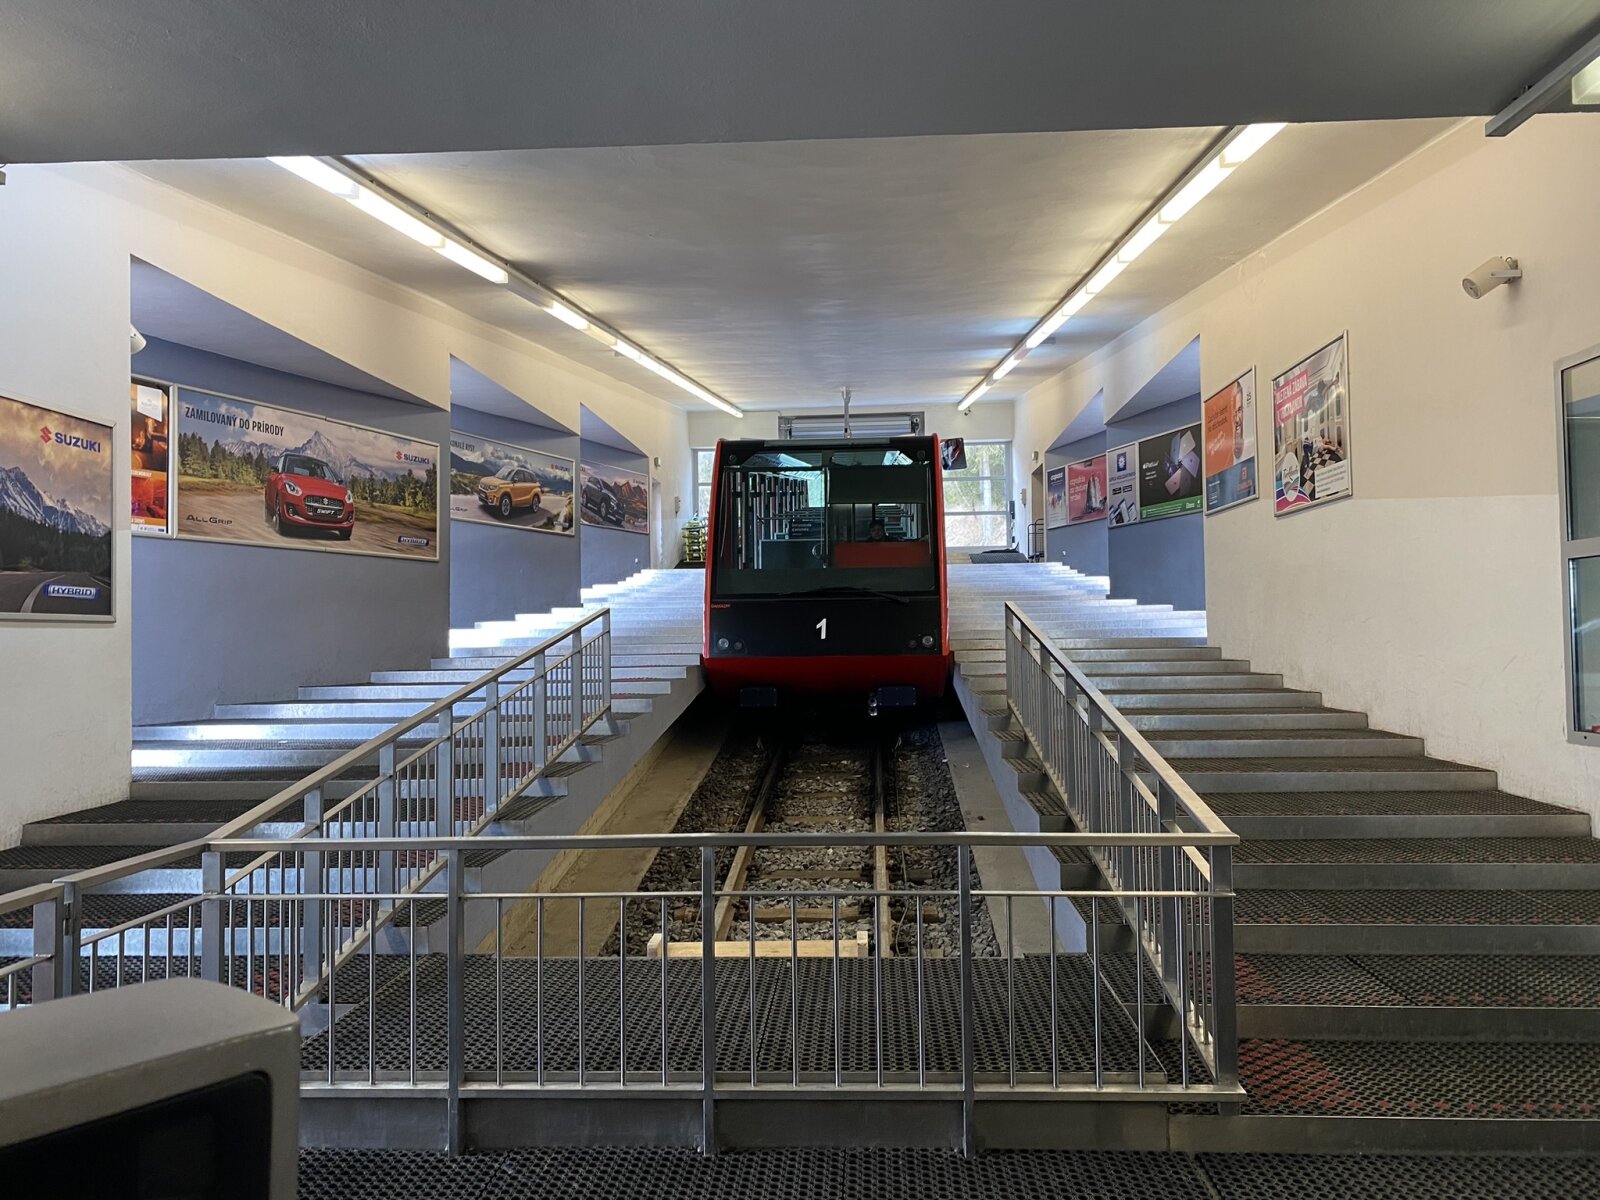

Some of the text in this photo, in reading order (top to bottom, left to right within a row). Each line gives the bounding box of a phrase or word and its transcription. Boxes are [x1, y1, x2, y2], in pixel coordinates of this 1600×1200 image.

[185, 406, 237, 427] ZAMILOVANÝ
[239, 418, 250, 430] DO
[54, 432, 101, 453] SUZUKI
[403, 453, 430, 465] SUZUKI
[52, 586, 93, 597] HYBRID
[815, 617, 827, 640] 1
